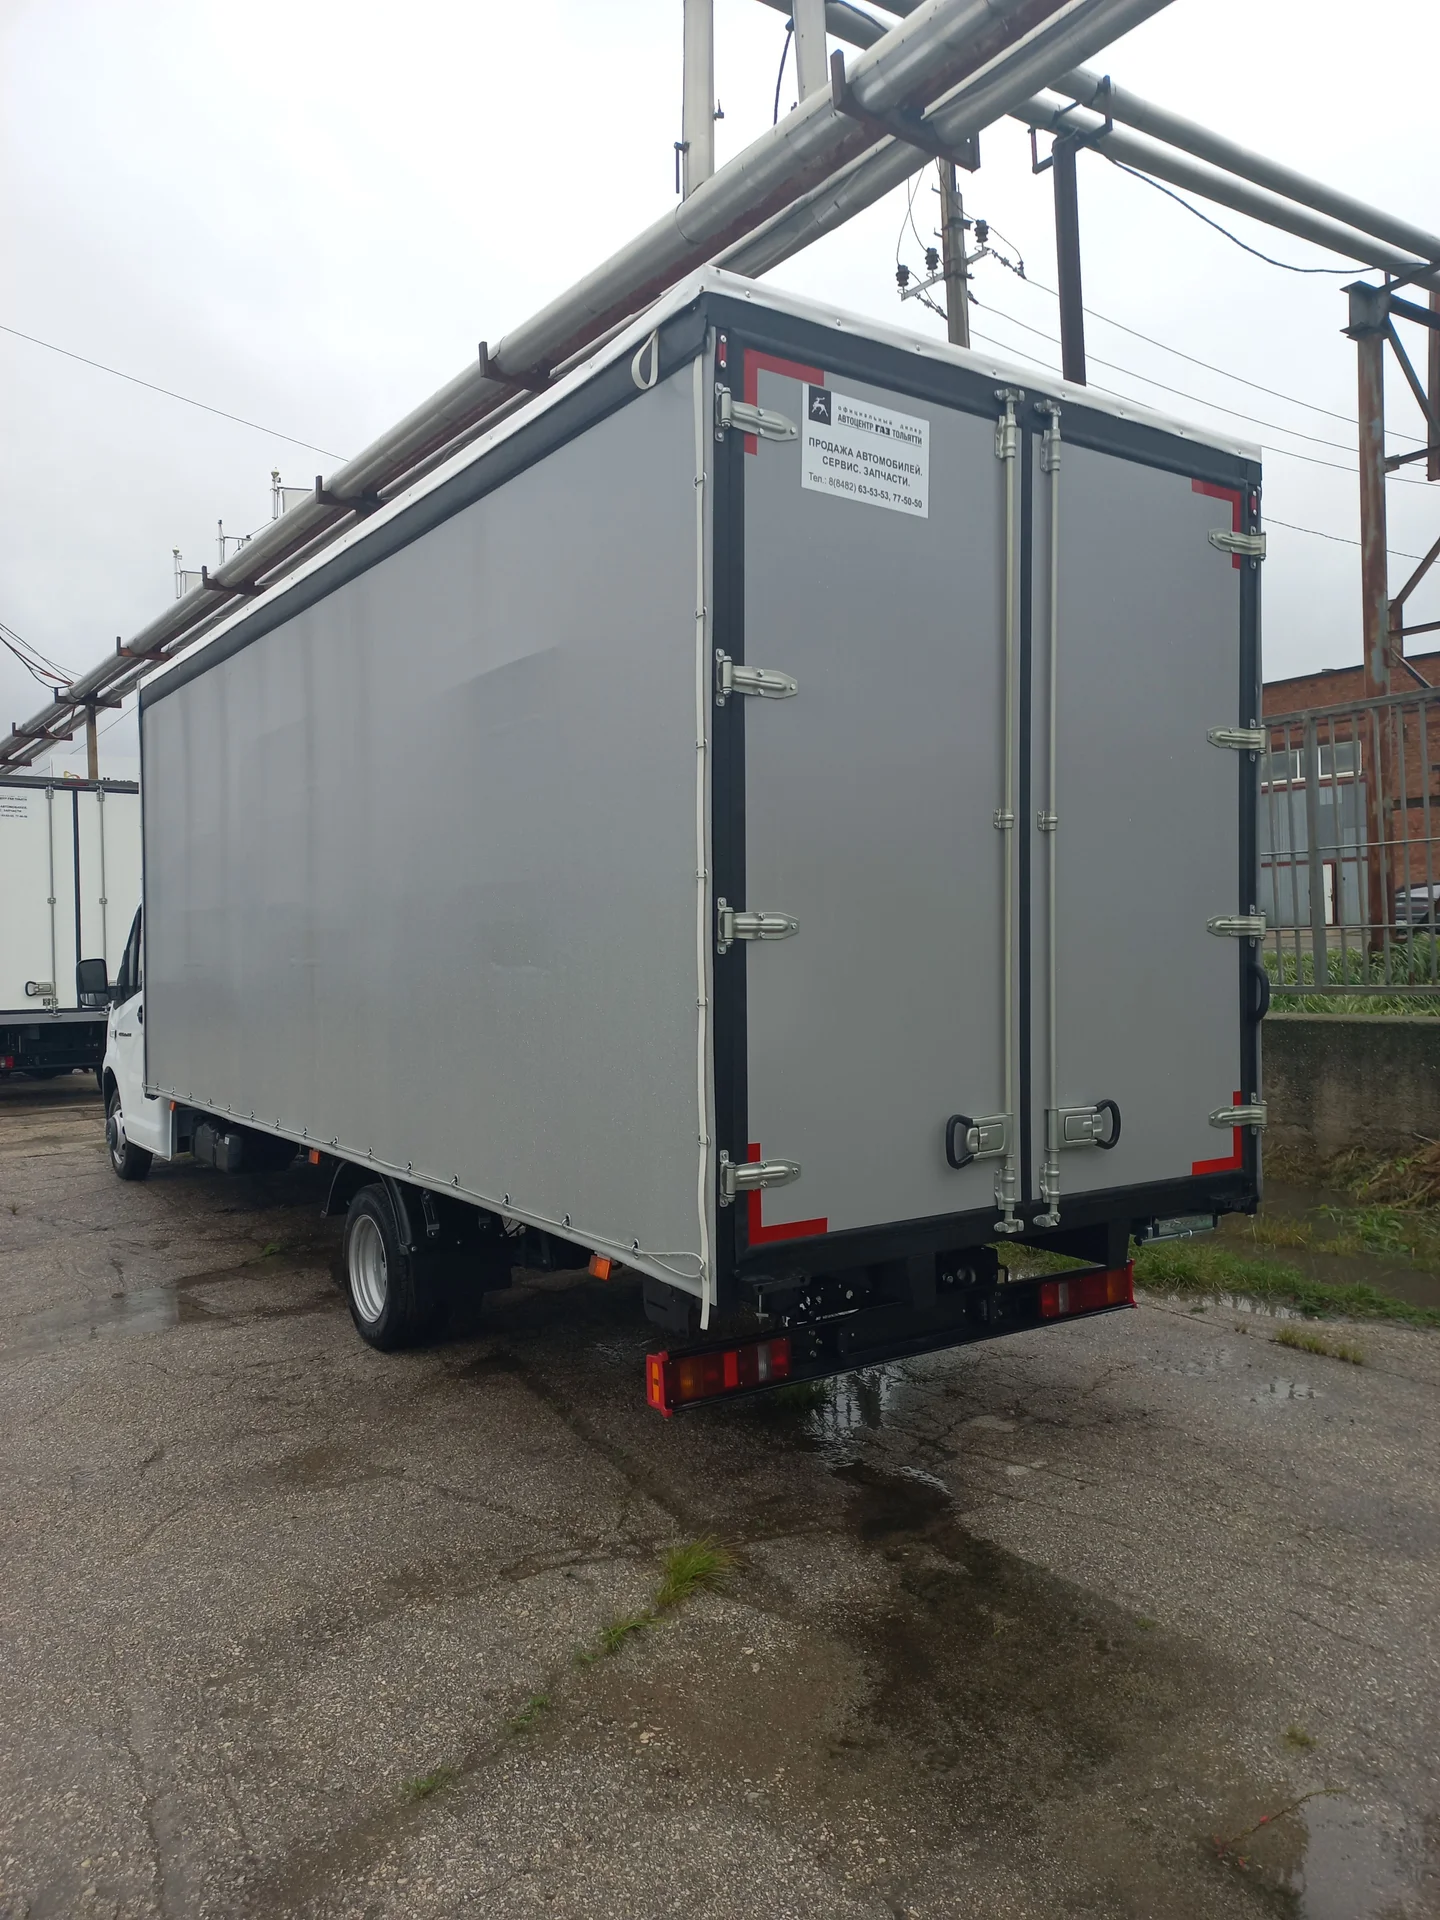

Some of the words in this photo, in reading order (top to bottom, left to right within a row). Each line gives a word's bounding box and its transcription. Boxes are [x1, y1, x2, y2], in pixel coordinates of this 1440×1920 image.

[838, 414, 874, 431] АВТОЦЕНТР
[875, 425, 890, 435] ГАЗ
[892, 429, 922, 445] ТОЛЬЯТТИ
[900, 425, 922, 434] дилер
[809, 437, 853, 457] ПРОДАЖА
[856, 450, 922, 476] АВТОМОБИЛЕЙ.
[822, 456, 861, 474] СЕРВИС.
[864, 467, 910, 486] ЗАПЧАСТИ.
[809, 472, 827, 484] Тел.:
[828, 477, 856, 493] 8(8482)
[858, 484, 891, 502] 63-53-53,
[893, 494, 922, 508] 77-50-50
